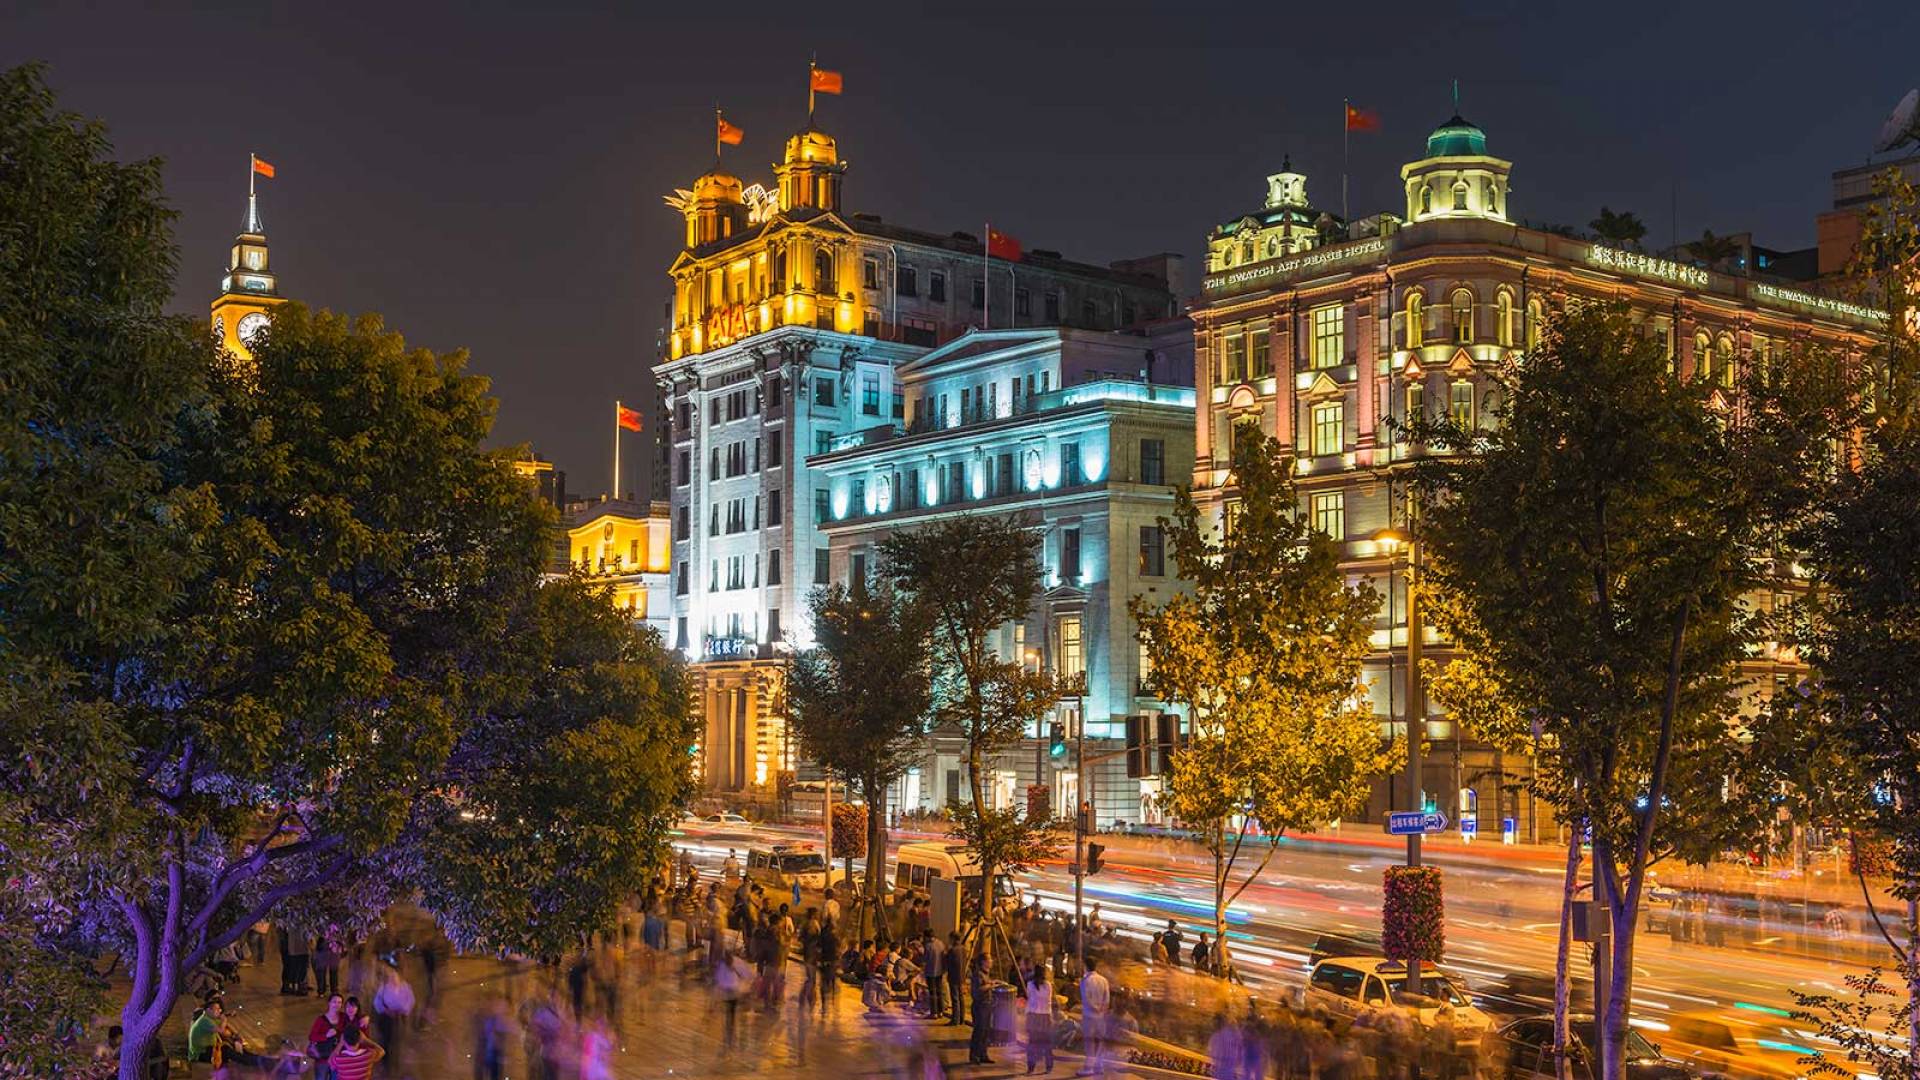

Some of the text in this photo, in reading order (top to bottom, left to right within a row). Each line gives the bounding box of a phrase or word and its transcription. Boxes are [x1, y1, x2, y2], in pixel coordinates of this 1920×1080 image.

[1204, 241, 1385, 289] THE SWATCH ART PEACE HOTEL
[1758, 284, 1891, 320] THE SWATCH ART PEACE HOTE
[708, 304, 748, 345] AIA
